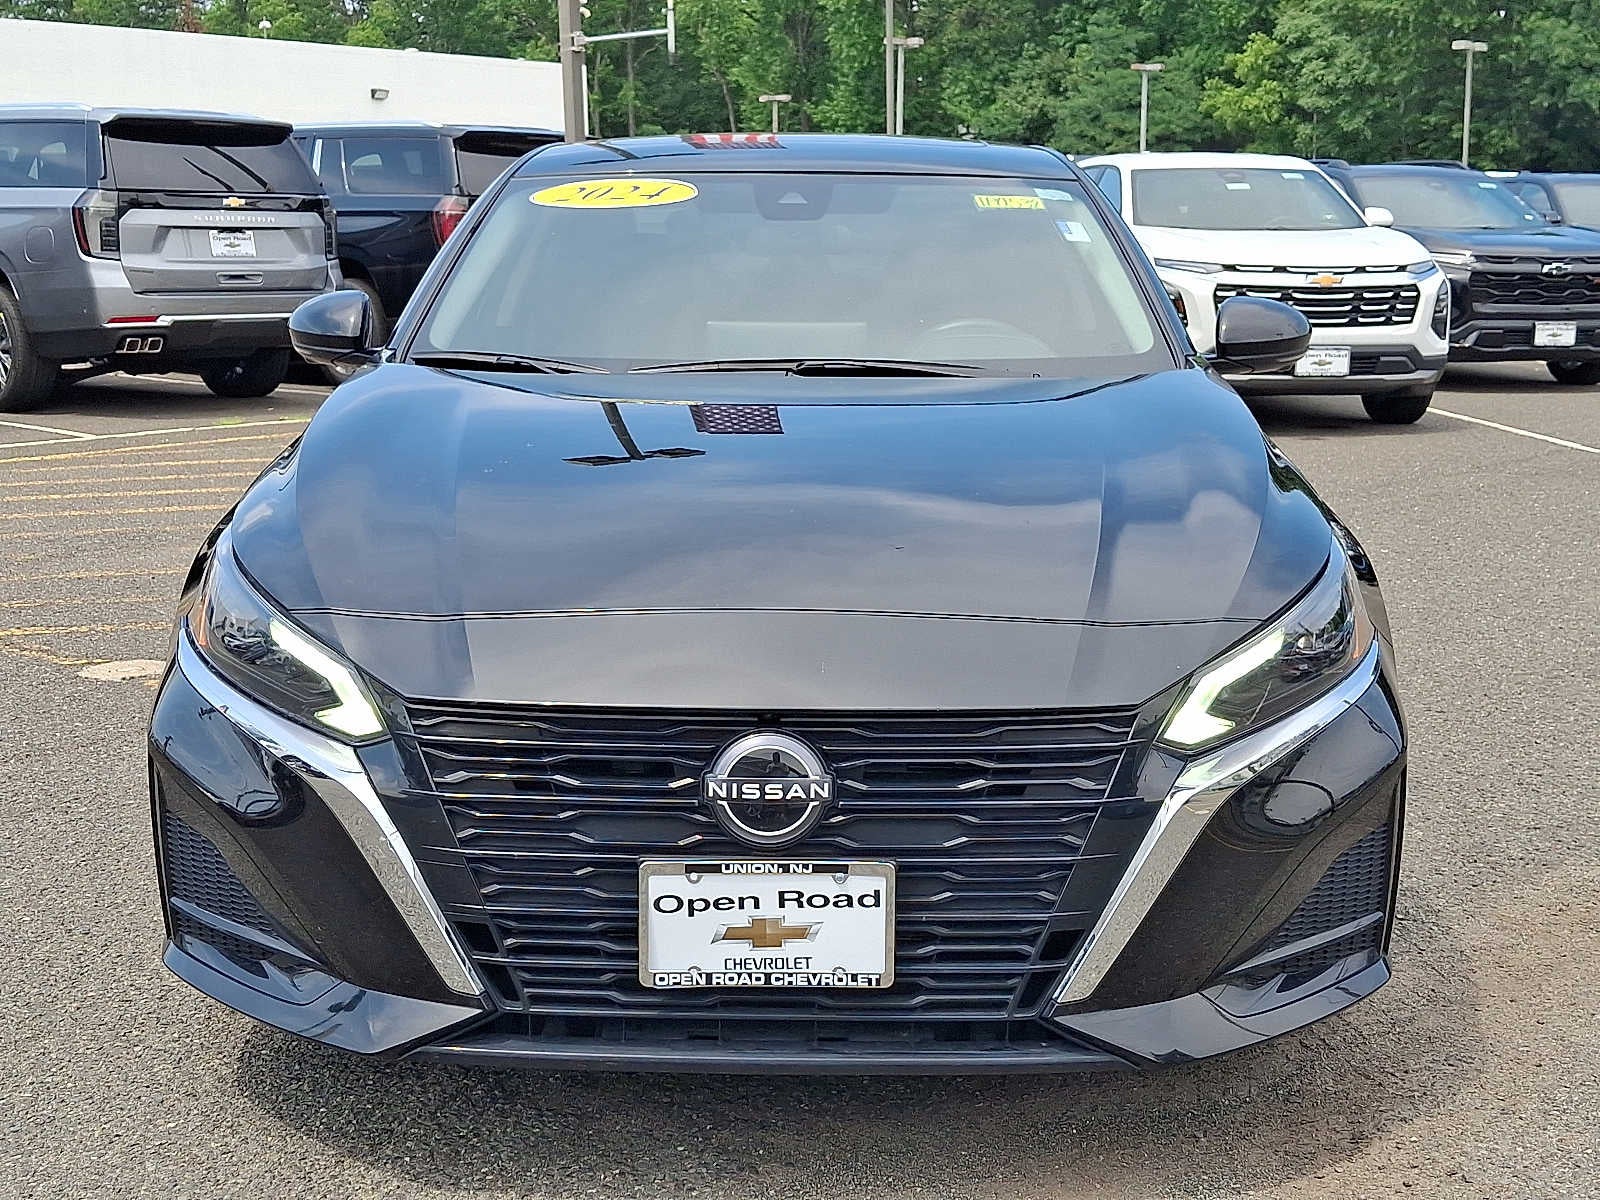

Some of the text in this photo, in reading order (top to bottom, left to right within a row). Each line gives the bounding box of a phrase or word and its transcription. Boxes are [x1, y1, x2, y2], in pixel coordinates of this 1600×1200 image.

[551, 185, 672, 202] 2024
[707, 782, 829, 800] NISSAN
[721, 863, 813, 874] UNION, NJ
[653, 889, 881, 917] Open Road
[724, 957, 813, 970] CHEVROLET
[654, 973, 880, 987] OPEN ROAD CHEVROLET
